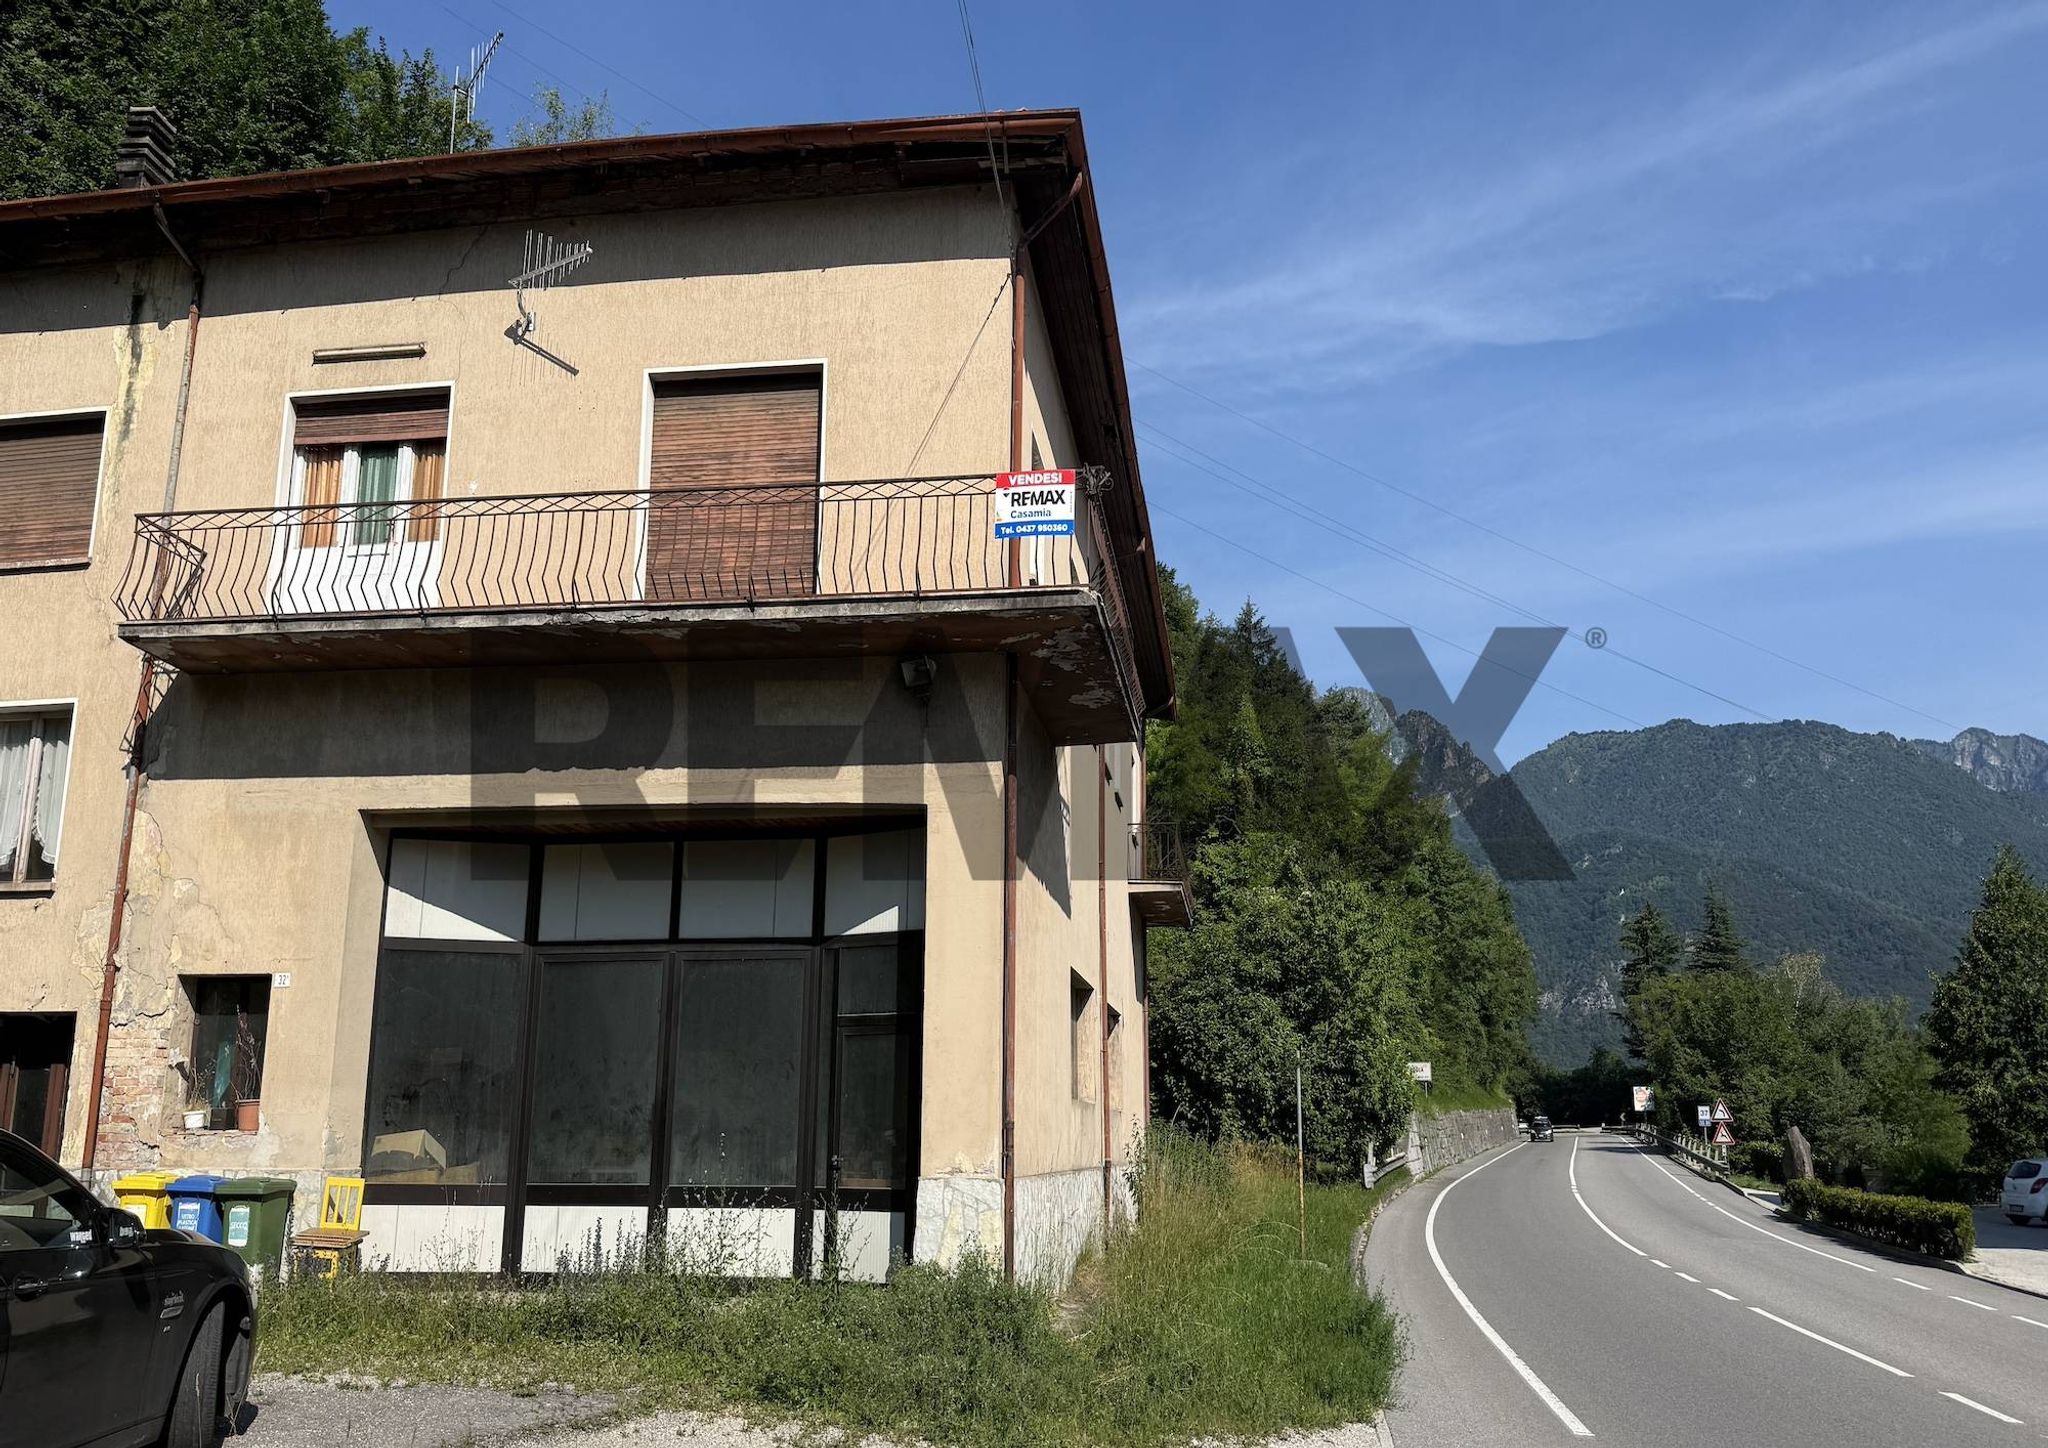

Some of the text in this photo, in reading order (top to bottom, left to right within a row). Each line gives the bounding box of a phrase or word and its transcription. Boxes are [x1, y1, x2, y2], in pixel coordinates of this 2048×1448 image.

[1008, 473, 1063, 486] VENDESI
[1010, 508, 1051, 518] Casamia
[1016, 524, 1037, 533] 0437
